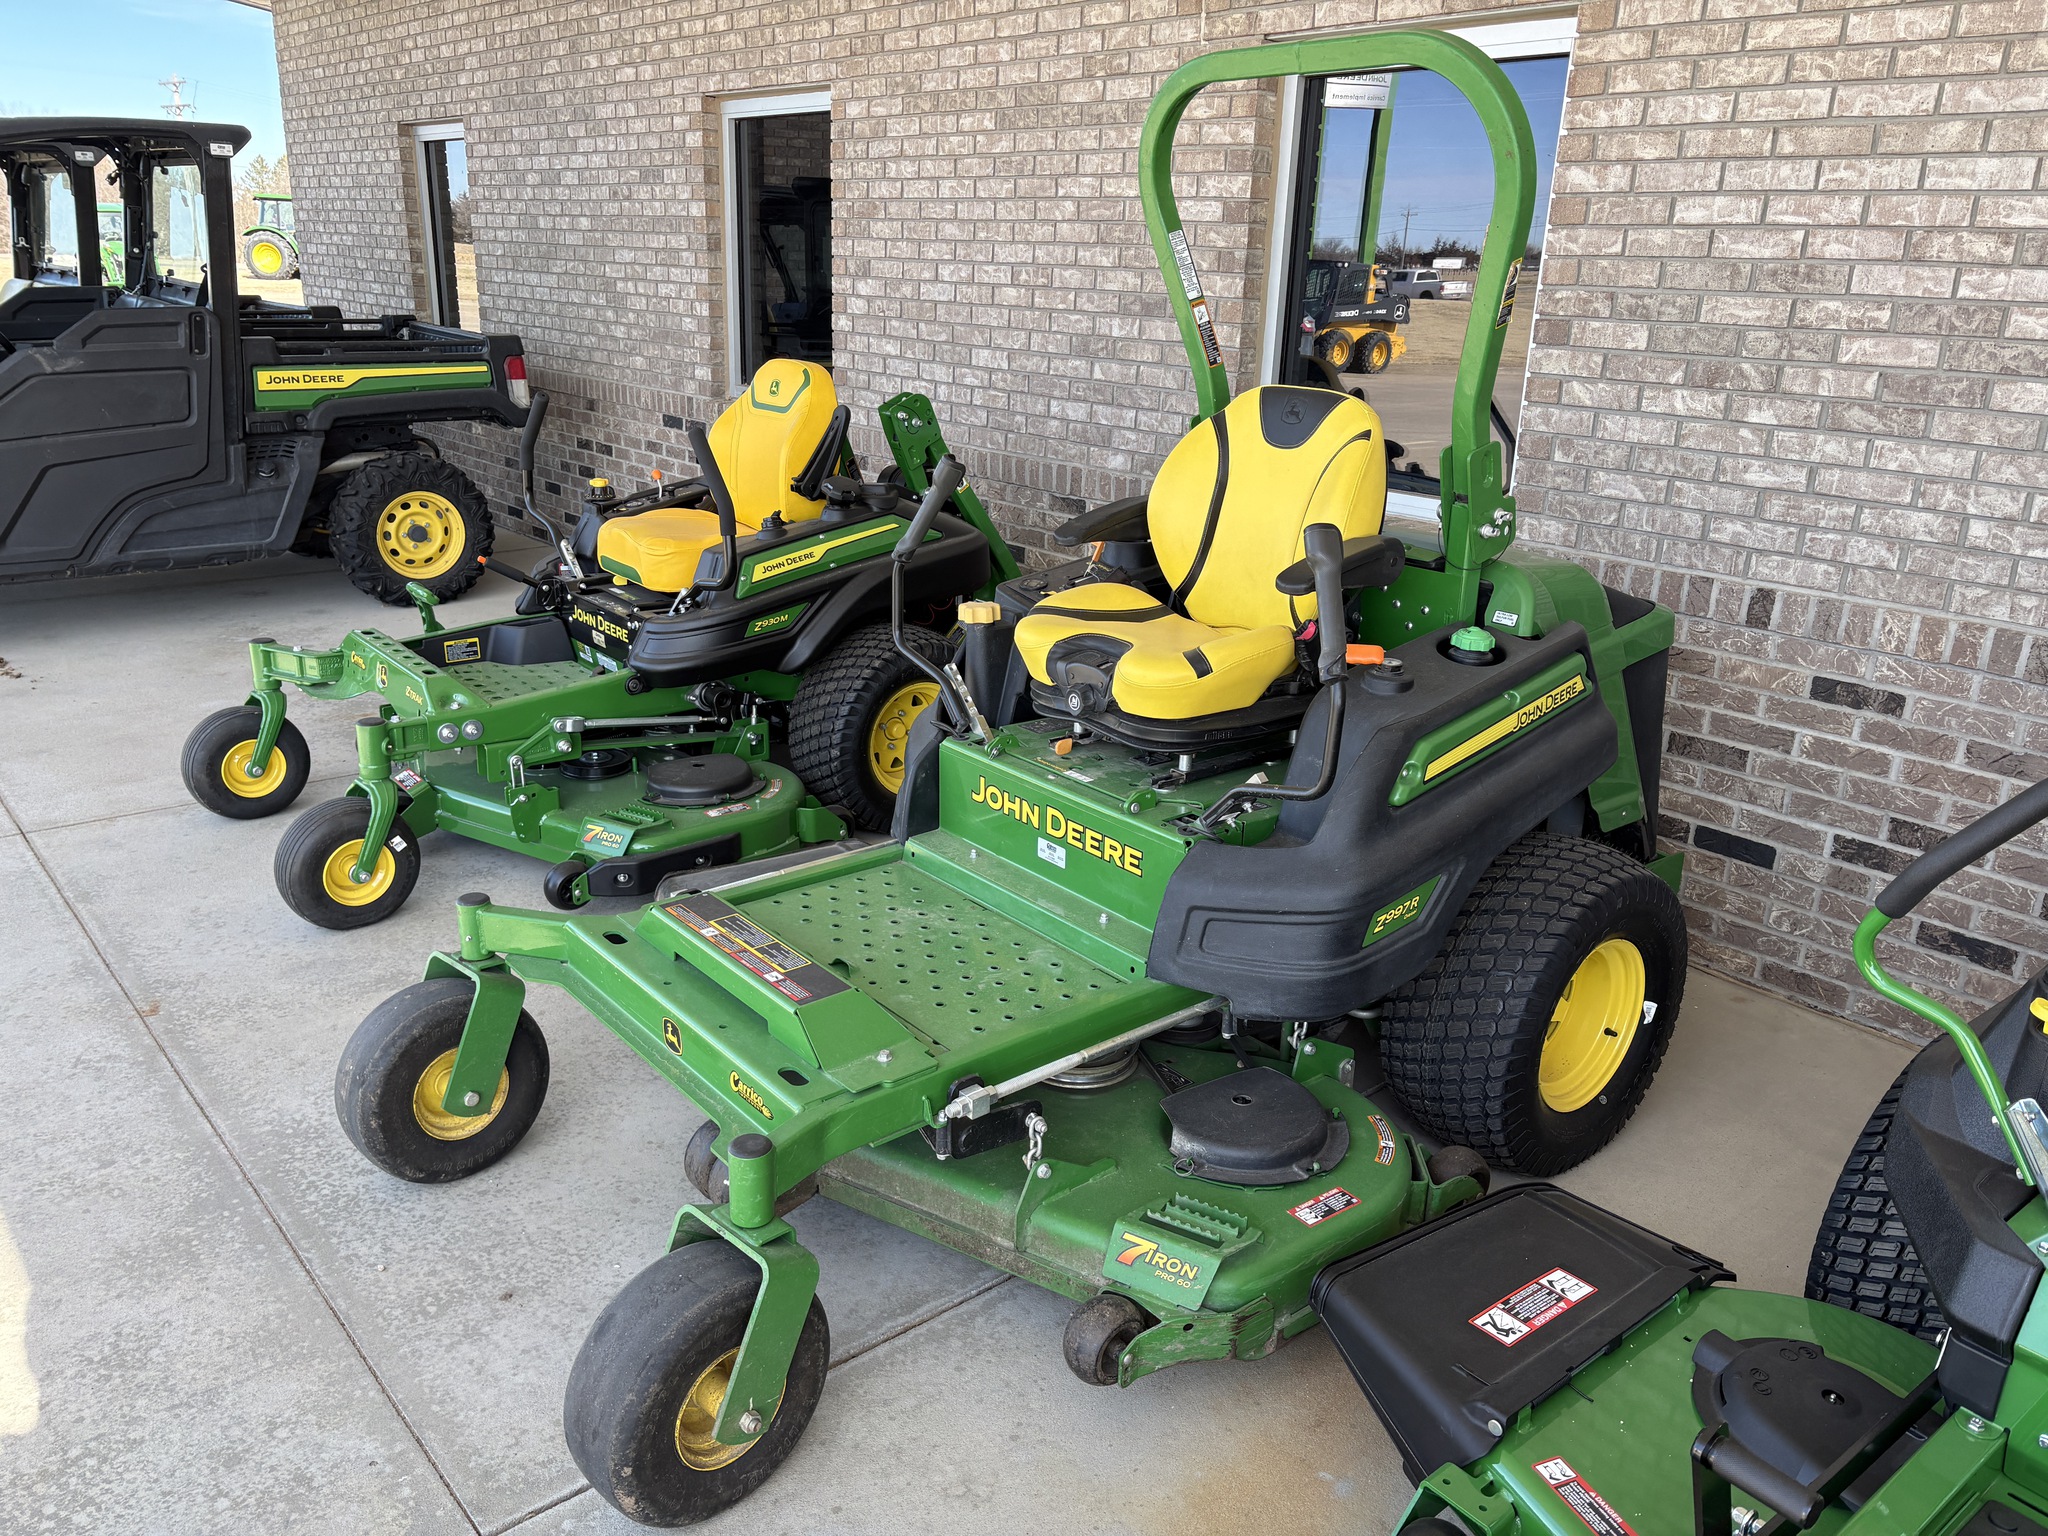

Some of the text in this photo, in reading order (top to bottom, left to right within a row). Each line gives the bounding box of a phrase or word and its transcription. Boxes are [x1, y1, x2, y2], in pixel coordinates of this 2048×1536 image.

[266, 374, 345, 384] JOHN DEERE
[762, 551, 816, 574] JOHN DEERE
[571, 604, 596, 628] JOHN
[597, 615, 629, 643] DEERE
[754, 614, 789, 632] Z930M
[1513, 682, 1578, 731] JOHN DEERE
[971, 775, 1040, 830] JOHN
[1046, 804, 1143, 878] DEERE
[1373, 895, 1420, 934] Z997R
[729, 1070, 764, 1107] Carrico
[1154, 1270, 1191, 1288] PRO 60
[1531, 1304, 1564, 1327] DANGER
[1594, 1495, 1623, 1524] DANGER
